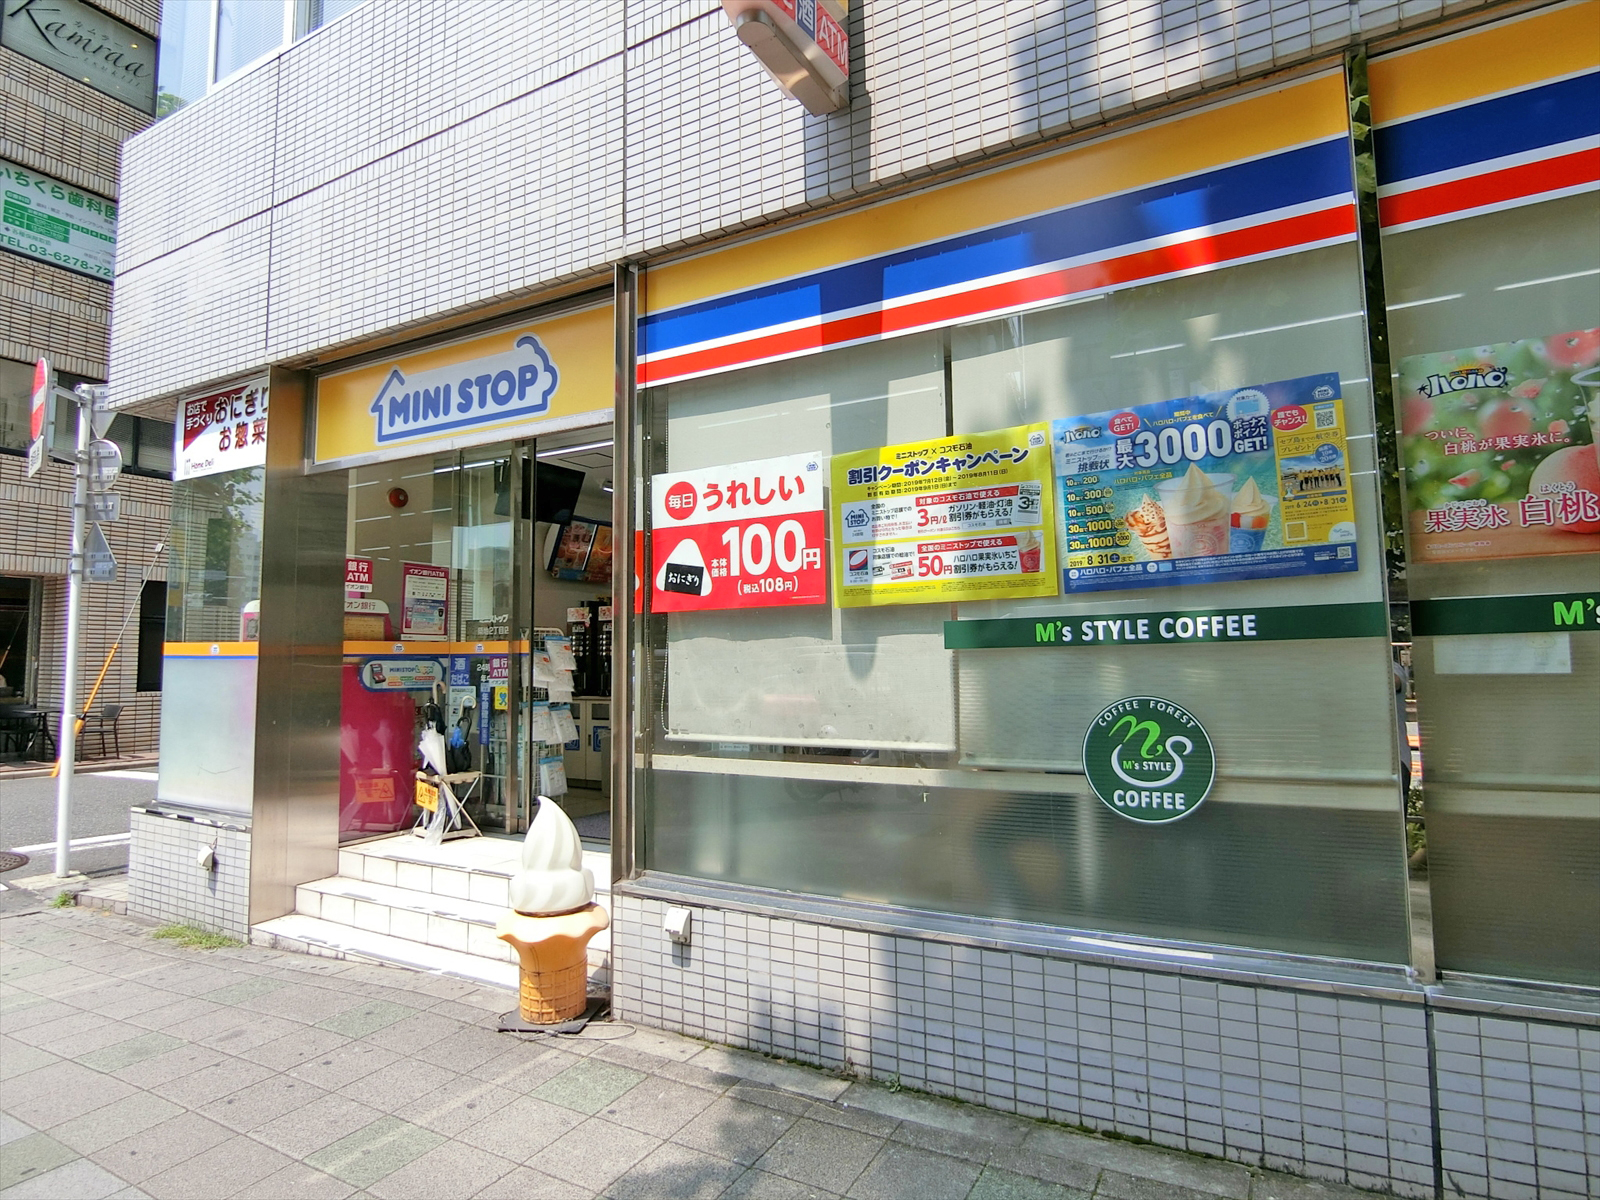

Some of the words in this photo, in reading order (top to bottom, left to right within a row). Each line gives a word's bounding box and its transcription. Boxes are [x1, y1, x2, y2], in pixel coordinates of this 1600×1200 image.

[819, 15, 848, 71] ATM
[388, 382, 451, 428] MINI
[456, 363, 539, 414] STOP
[186, 400, 208, 416] お店で
[185, 412, 213, 430] 手づくり
[1113, 423, 1135, 432] GET!
[1114, 416, 1133, 425] 食べて
[1233, 416, 1267, 430] ボーナス
[1274, 415, 1306, 427] チャンス!
[1233, 427, 1268, 439] ポイント
[1425, 427, 1475, 441] ついに、
[895, 449, 929, 459] ミニストップ
[940, 442, 972, 454] コスモ石油
[1116, 438, 1134, 470] 最大
[1134, 419, 1232, 468] 3000
[1234, 436, 1268, 453] GET!
[1444, 432, 1572, 456] 白桃が果実氷に。
[848, 448, 1029, 485] 割引クーポンキャンペーン
[1078, 460, 1110, 473] 挑戦状
[1083, 476, 1098, 484] 200
[668, 493, 694, 510] 毎日
[703, 475, 805, 512] うれしい
[1084, 490, 1102, 499] 300
[1539, 482, 1576, 494] はくとう
[919, 490, 1000, 505] 対象のコスモ石油で使える
[949, 508, 1013, 522] 割引券がもらえる!
[1086, 505, 1103, 515] 500
[1425, 505, 1509, 533] 果実氷
[1519, 491, 1600, 528] 白桃
[850, 518, 865, 526] STOP
[1087, 519, 1112, 532] 1000
[721, 519, 822, 577] 100円
[921, 538, 1003, 552] 全国のミニストップで使える
[1088, 536, 1113, 548] 1000
[711, 558, 728, 568] 本体
[953, 550, 1017, 563] ハロハロ果実氷いちご
[1087, 555, 1093, 565] 8
[1097, 554, 1109, 564] 31
[347, 560, 369, 572] 銀行
[711, 567, 728, 577] 価格
[918, 555, 952, 577] 50円
[953, 561, 1018, 574] 割引券がもらえる!
[1080, 564, 1143, 576] ハロハロ・パフェ全品
[346, 572, 369, 582] ATM
[667, 571, 700, 587] おにぎり
[737, 576, 799, 596] (税込108円)
[1553, 598, 1600, 626] M'
[1035, 621, 1073, 642] M's
[1081, 618, 1150, 642] STYLE
[1159, 614, 1257, 639] COFFEE
[454, 657, 467, 671] 酒
[492, 658, 508, 668] 銀行
[450, 673, 470, 685] たばこ
[492, 668, 508, 677] ATM
[1098, 700, 1140, 727] COFFEE
[1149, 700, 1196, 729] FOREST
[1122, 760, 1140, 770] M's
[1142, 761, 1172, 771] STYLE
[1113, 789, 1186, 810] COFFEE
